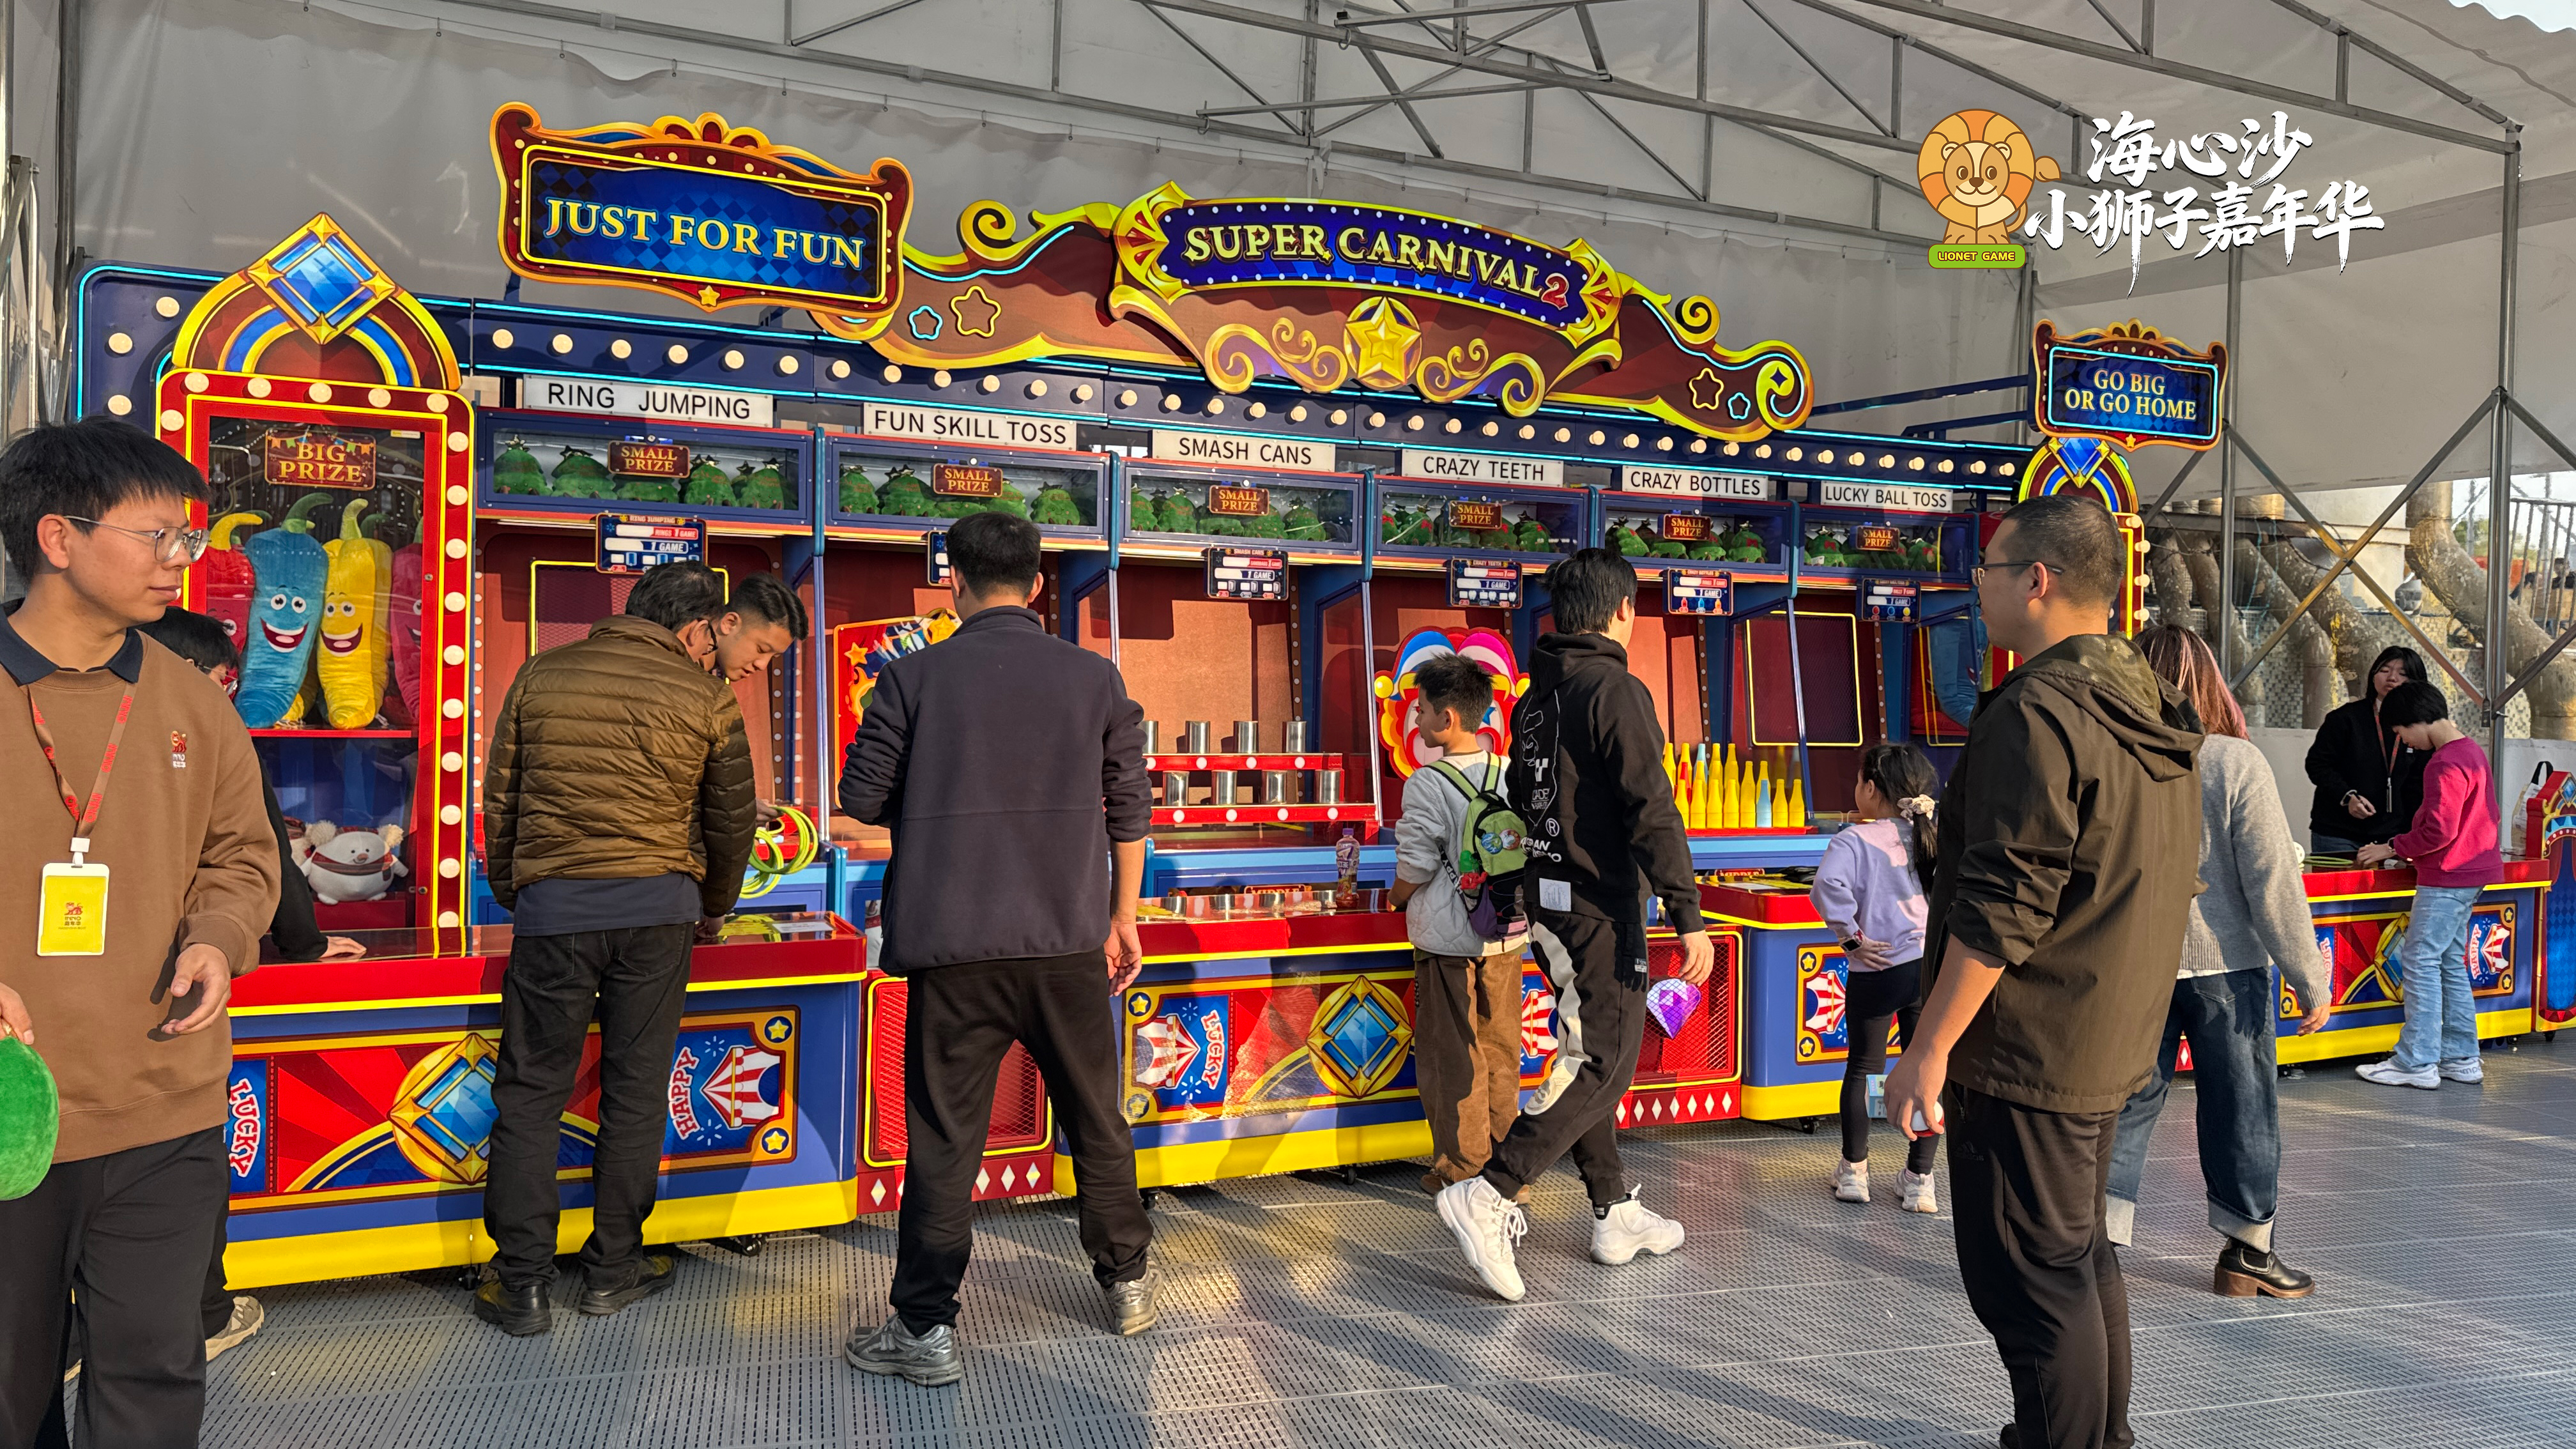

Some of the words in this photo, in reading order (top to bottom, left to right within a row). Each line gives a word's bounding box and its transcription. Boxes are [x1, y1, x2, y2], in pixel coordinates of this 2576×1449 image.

[544, 198, 657, 240] JUST
[669, 215, 762, 256] FOR
[772, 228, 865, 270] FUN
[1184, 224, 1332, 264] SUPER
[1339, 227, 1542, 296] CARNIVAL
[1541, 273, 1569, 310] 2
[2094, 369, 2125, 390] GO
[2130, 374, 2165, 394] BIG
[548, 383, 615, 408] RING
[639, 391, 750, 420] JUMPING
[2066, 389, 2095, 410] OR
[2100, 393, 2129, 413] GO
[2136, 399, 2196, 420] HOME
[875, 410, 924, 433] FUN
[933, 415, 1000, 440] SKILL
[1006, 422, 1066, 444] TOSS
[296, 442, 346, 463] BIG
[621, 446, 677, 461] SMALL
[1179, 437, 1249, 461] SMASH
[1260, 445, 1312, 465] CANS
[279, 460, 362, 483] PRIZE
[624, 458, 675, 472] PRIZE
[945, 468, 992, 482] SMALL
[1423, 456, 1480, 478] CRAZY
[1489, 461, 1544, 482] TEETH
[947, 480, 990, 493] PRIZE
[1630, 472, 1682, 491] CRAZY
[1690, 476, 1761, 496] BOTTLES
[1219, 489, 1260, 502] SMALL
[1222, 500, 1258, 512] PRIZE
[1825, 487, 1869, 503] LUCKY
[1876, 489, 1910, 506] BALL
[1913, 491, 1947, 509] TOSS
[1457, 504, 1494, 516] SMALL
[1460, 514, 1492, 525] PRIZE
[674, 528, 678, 537] 1
[1671, 518, 1704, 528] SMALL
[1673, 526, 1702, 537] PRIZE
[1863, 530, 1893, 539] SMALL
[1865, 538, 1892, 548] PRIZE
[651, 542, 656, 551] 1
[659, 542, 684, 552] GAME
[1254, 571, 1272, 579] GAME
[2469, 923, 2483, 980] HAPPY
[1200, 1009, 1225, 1090] LUCKY
[668, 1046, 700, 1140] HAPPY
[229, 1078, 262, 1177] LUCKY
